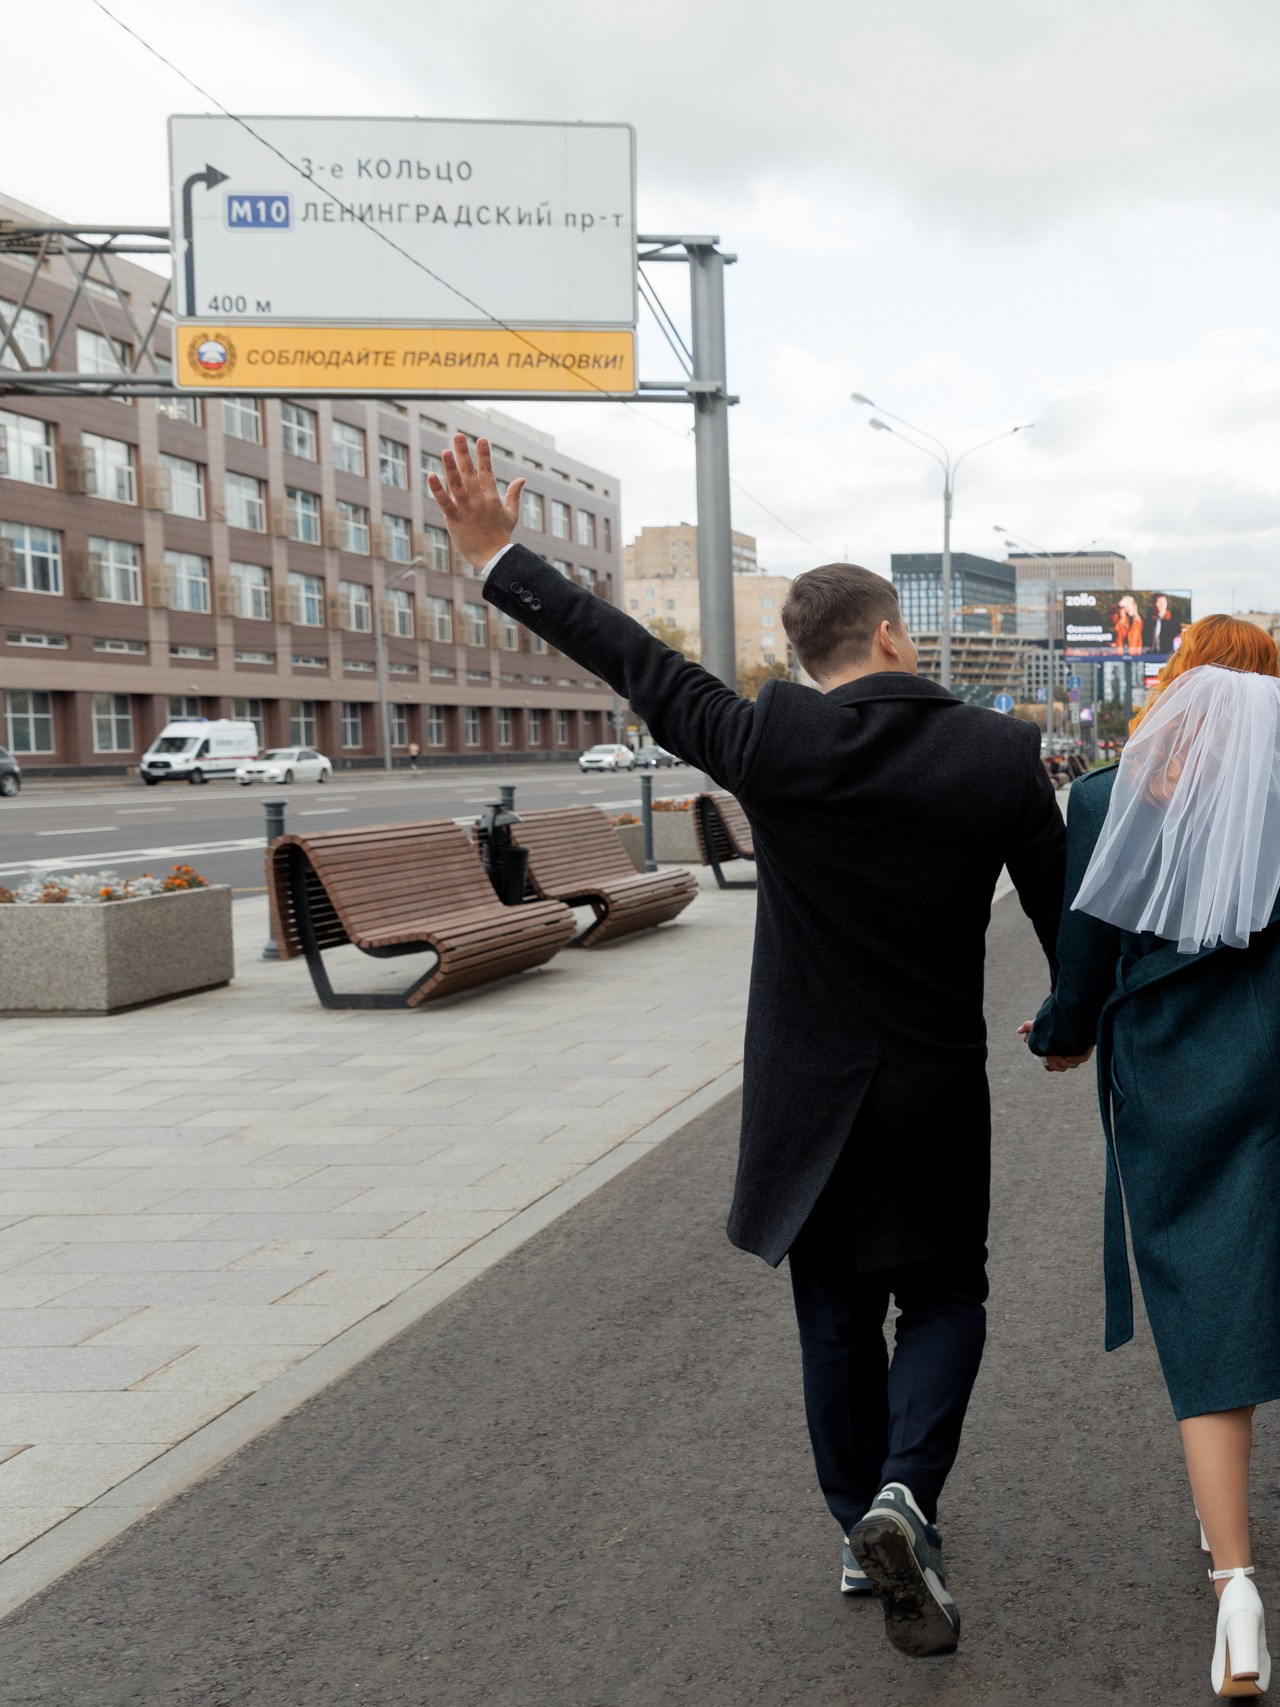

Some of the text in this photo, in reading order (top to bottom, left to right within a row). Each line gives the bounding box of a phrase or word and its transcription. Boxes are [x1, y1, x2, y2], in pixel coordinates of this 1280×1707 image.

[301, 157, 473, 183] 3-е КОЛЬЦО
[230, 200, 287, 223] М10
[301, 201, 624, 233] ЛЕНИНГРАДСКИЙ пр-т
[208, 295, 272, 313] 400 м
[246, 347, 625, 370] СОБЛЮДАЙТЕ ПРАВИЛА ПАРКОВКИ!
